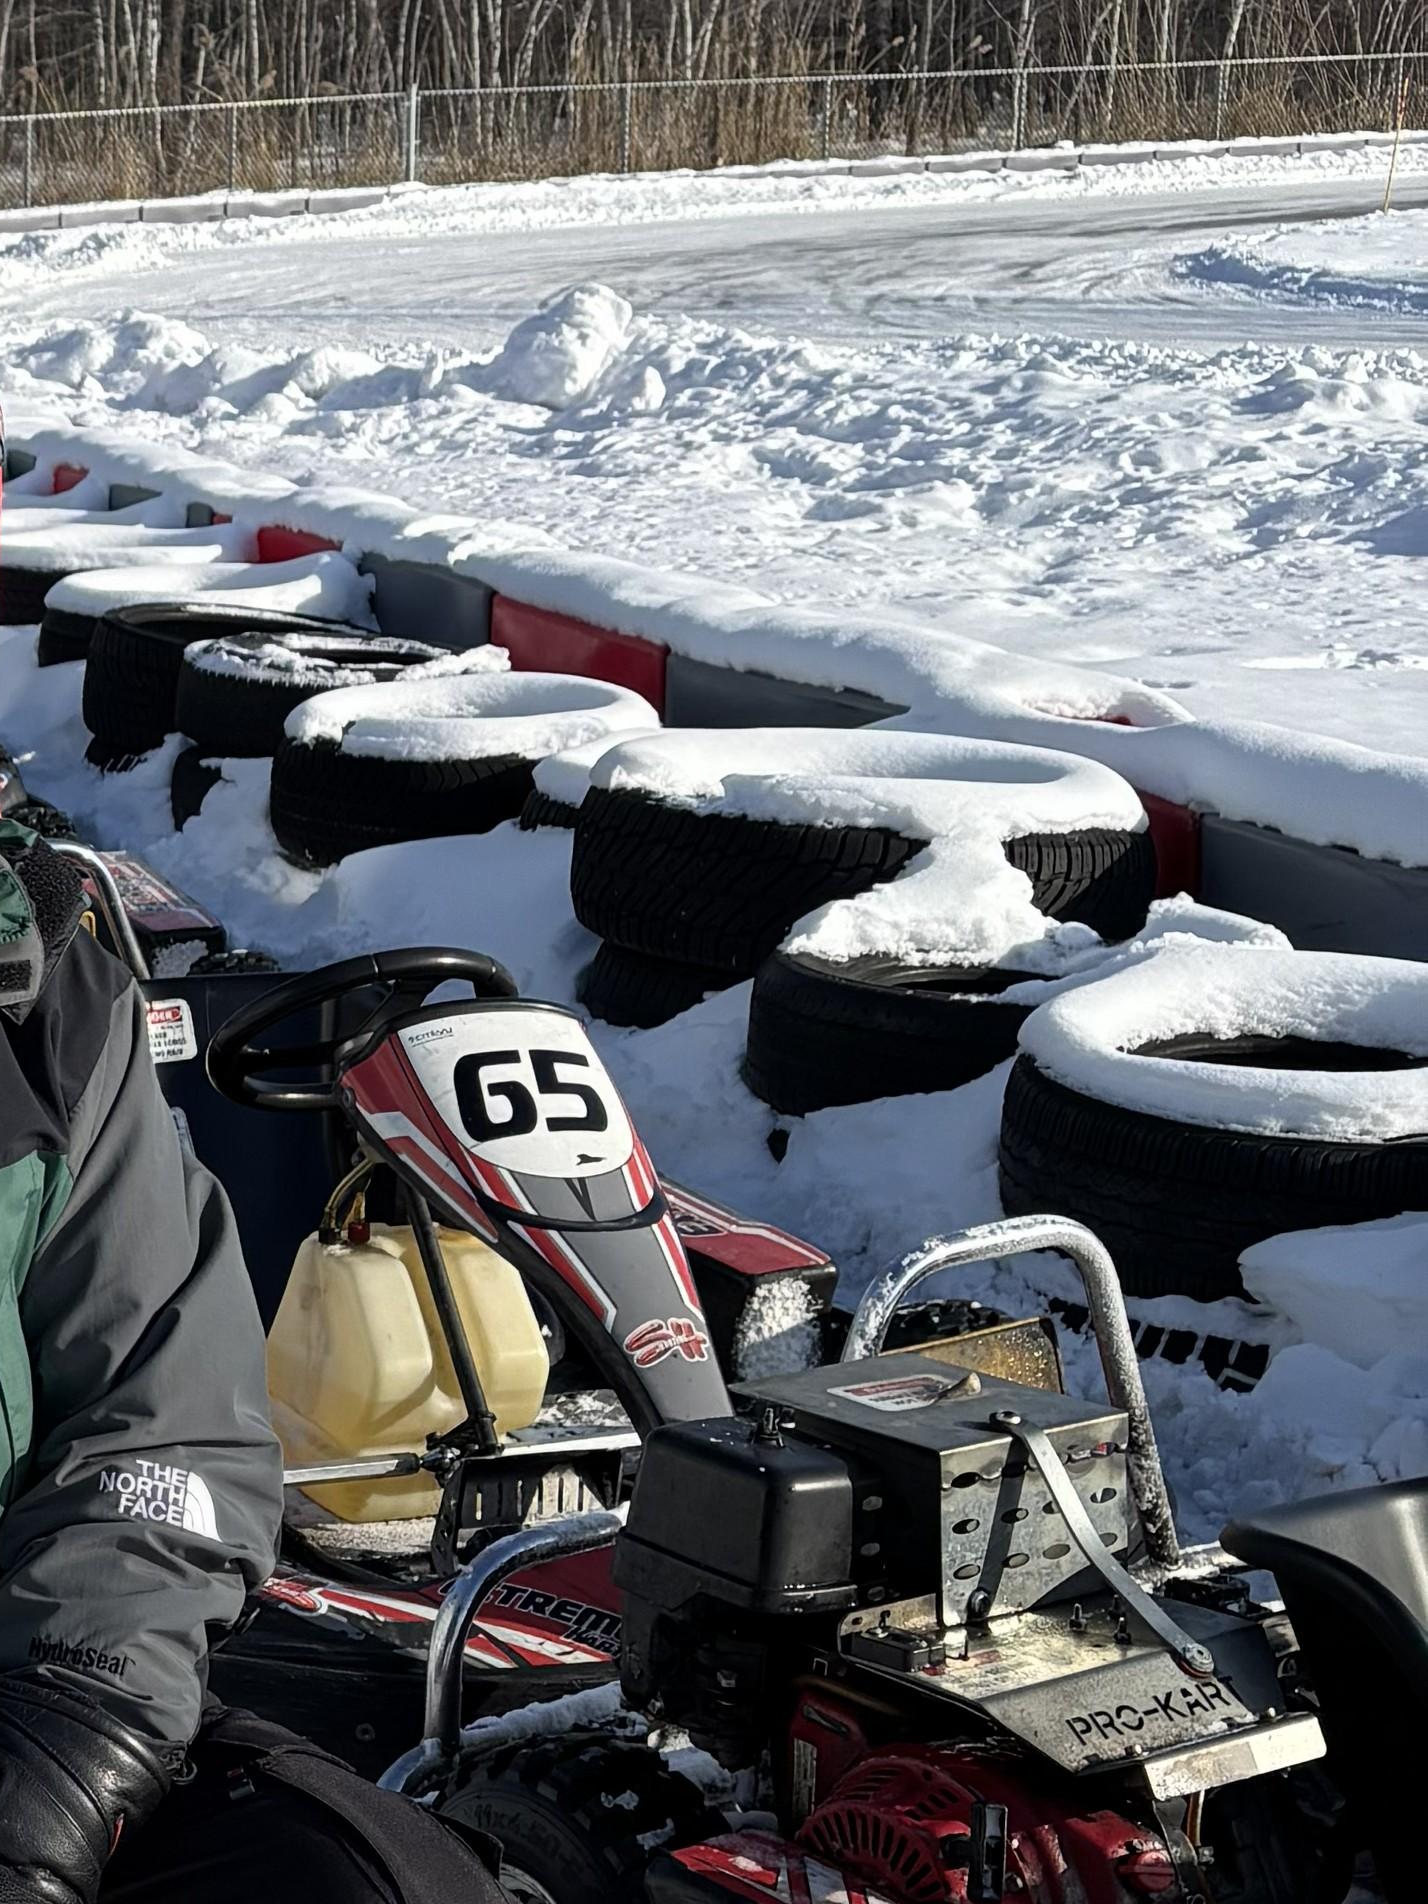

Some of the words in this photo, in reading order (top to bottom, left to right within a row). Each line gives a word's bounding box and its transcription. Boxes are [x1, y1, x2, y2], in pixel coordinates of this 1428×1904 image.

[453, 1049, 609, 1143] 65
[99, 1470, 185, 1508] NORTH
[135, 1460, 187, 1486] THE
[117, 1495, 184, 1525] FACE
[1065, 1676, 1242, 1746] PRO-KART
